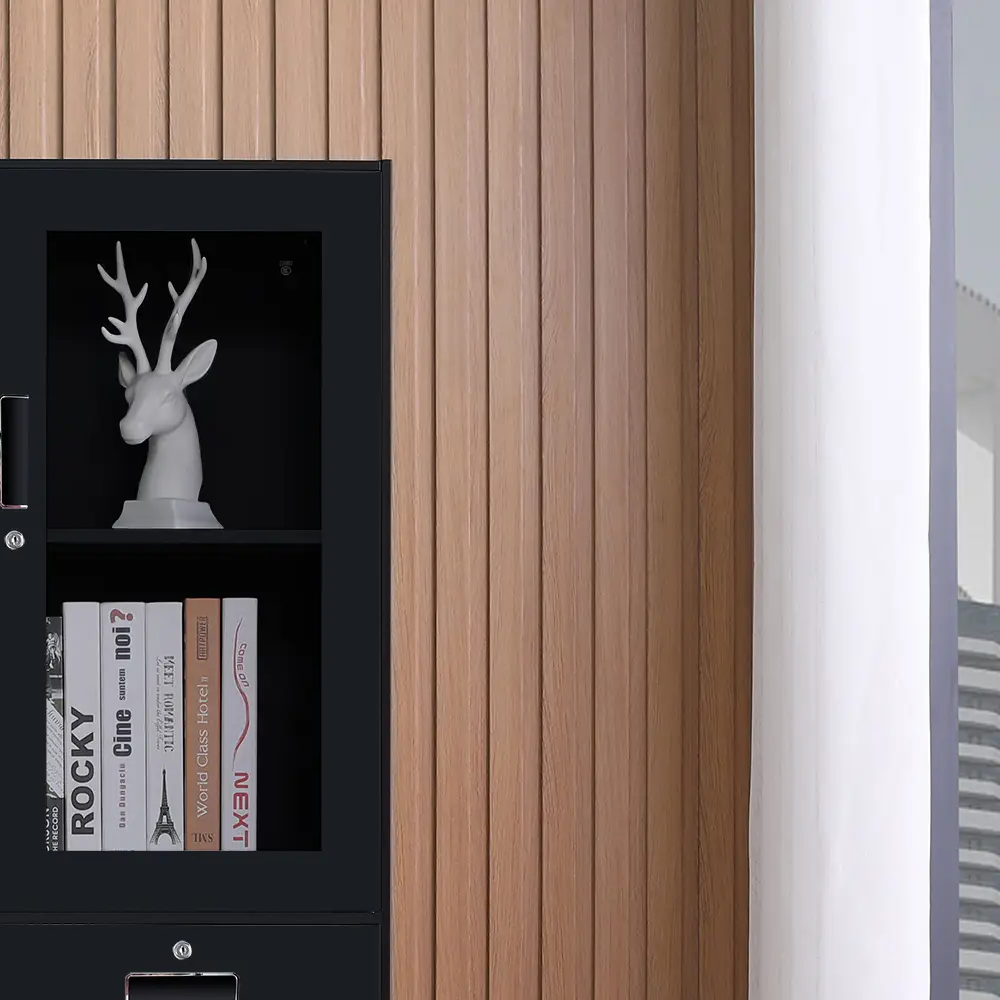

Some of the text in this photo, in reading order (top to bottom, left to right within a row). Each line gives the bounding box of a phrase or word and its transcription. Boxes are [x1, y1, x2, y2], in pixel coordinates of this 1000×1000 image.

[118, 668, 126, 701] suntem
[163, 655, 175, 752] MEET ROMANTIC
[196, 684, 208, 724] Hotel
[113, 708, 132, 757] Cine
[196, 729, 208, 767] Class
[70, 706, 94, 835] ROCKY
[196, 771, 208, 818] World
[232, 772, 249, 847] NEXT
[118, 811, 126, 828] Dan
